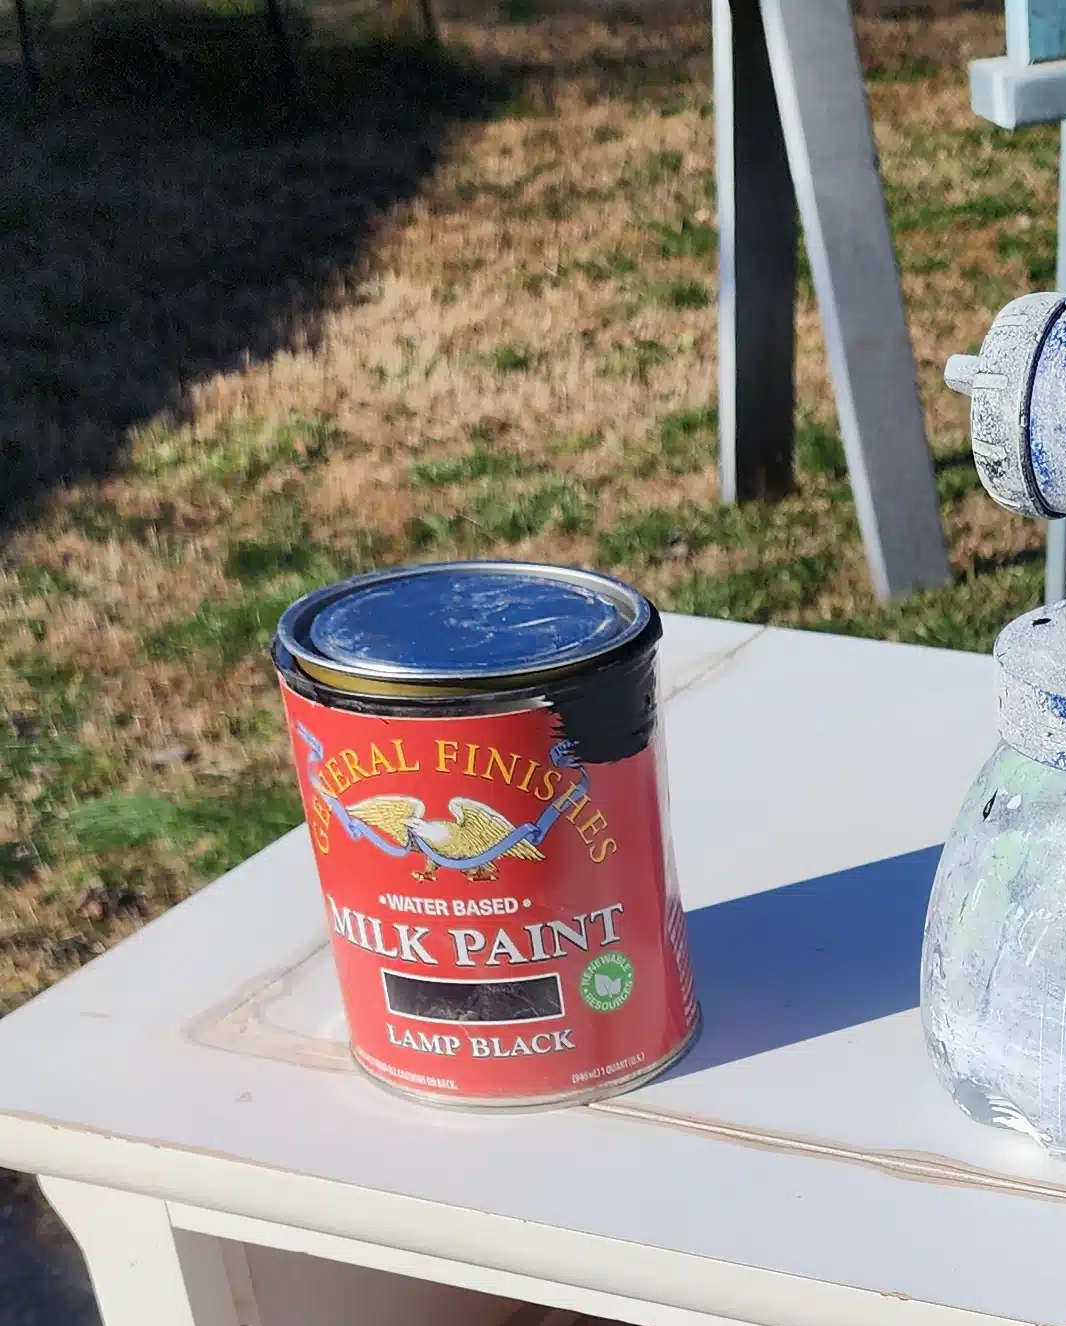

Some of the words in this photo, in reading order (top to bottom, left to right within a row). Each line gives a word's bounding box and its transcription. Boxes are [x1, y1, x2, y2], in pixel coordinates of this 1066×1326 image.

[312, 738, 420, 855] GENERAL
[434, 739, 617, 864] FINISHES
[326, 894, 439, 966] MILK
[448, 902, 625, 967] PAINT
[385, 893, 450, 916] WATER
[452, 896, 518, 917] BASED
[386, 1023, 460, 1056] LAMP
[471, 1028, 576, 1058] BLACK
